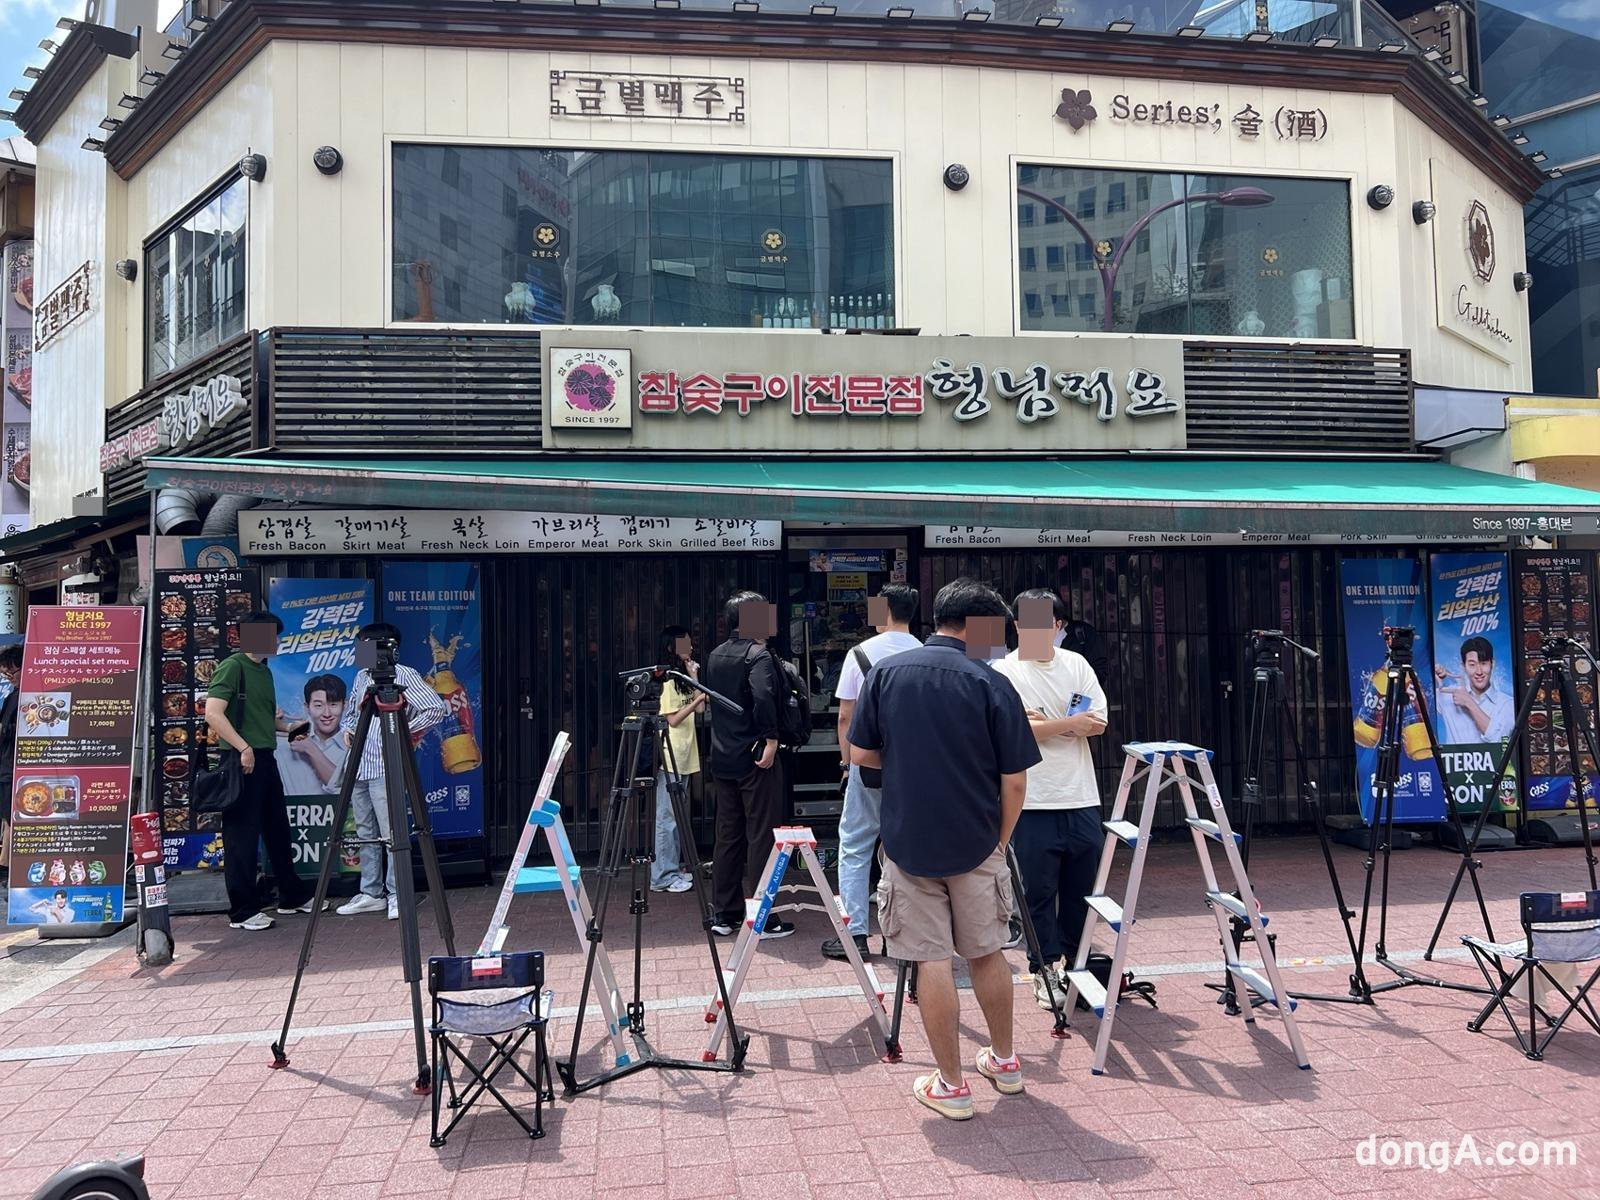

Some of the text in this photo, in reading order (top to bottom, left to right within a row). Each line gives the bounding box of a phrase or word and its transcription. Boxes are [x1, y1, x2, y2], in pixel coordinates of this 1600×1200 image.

[576, 78, 724, 115] 금별맥주
[1233, 104, 1263, 138] 술
[41, 275, 83, 340] 금별맥주
[639, 357, 1183, 424] 참숯구이전문점 형님저요
[565, 416, 620, 424] SINCE 1997
[258, 515, 316, 540] 삼겹살
[335, 515, 411, 540] 갈매기살
[452, 515, 489, 539] 목살
[531, 515, 604, 538] 가브리살
[1472, 517, 1502, 530] Since
[249, 537, 775, 551] Fresh Bacon Skirt Meat Fresh Neck Loin Emperor Meat Pork Skin Grilled Beef Ribs
[935, 534, 964, 544] Fresh
[969, 535, 1001, 544] Bacon
[1038, 534, 1061, 543] Skirt
[1066, 534, 1091, 543] Meat
[1128, 533, 1156, 542] Fresh
[1160, 533, 1186, 542] Neck
[1191, 533, 1212, 542] Loin
[1242, 533, 1283, 543] Emperor
[1287, 534, 1310, 542] Meat
[1346, 585, 1421, 596] ONE TEAM EDITION
[1455, 571, 1502, 598] 강력한
[388, 590, 476, 602] ONE TEAM EDITION
[1437, 592, 1500, 622] 리얼탄산
[60, 621, 112, 629] SINCE 1997
[65, 610, 105, 621] 형님저요
[301, 602, 364, 630] 강력한
[1460, 612, 1500, 637] 100%
[276, 624, 361, 656] 리얼탄산
[33, 657, 59, 665] Lunch
[60, 657, 90, 666] special
[305, 647, 356, 674] 100%
[1364, 692, 1387, 711] Cas
[1441, 751, 1495, 773] TERRA
[425, 786, 449, 804] Cass
[1529, 781, 1550, 798] Cass
[286, 804, 335, 827] ERRA
